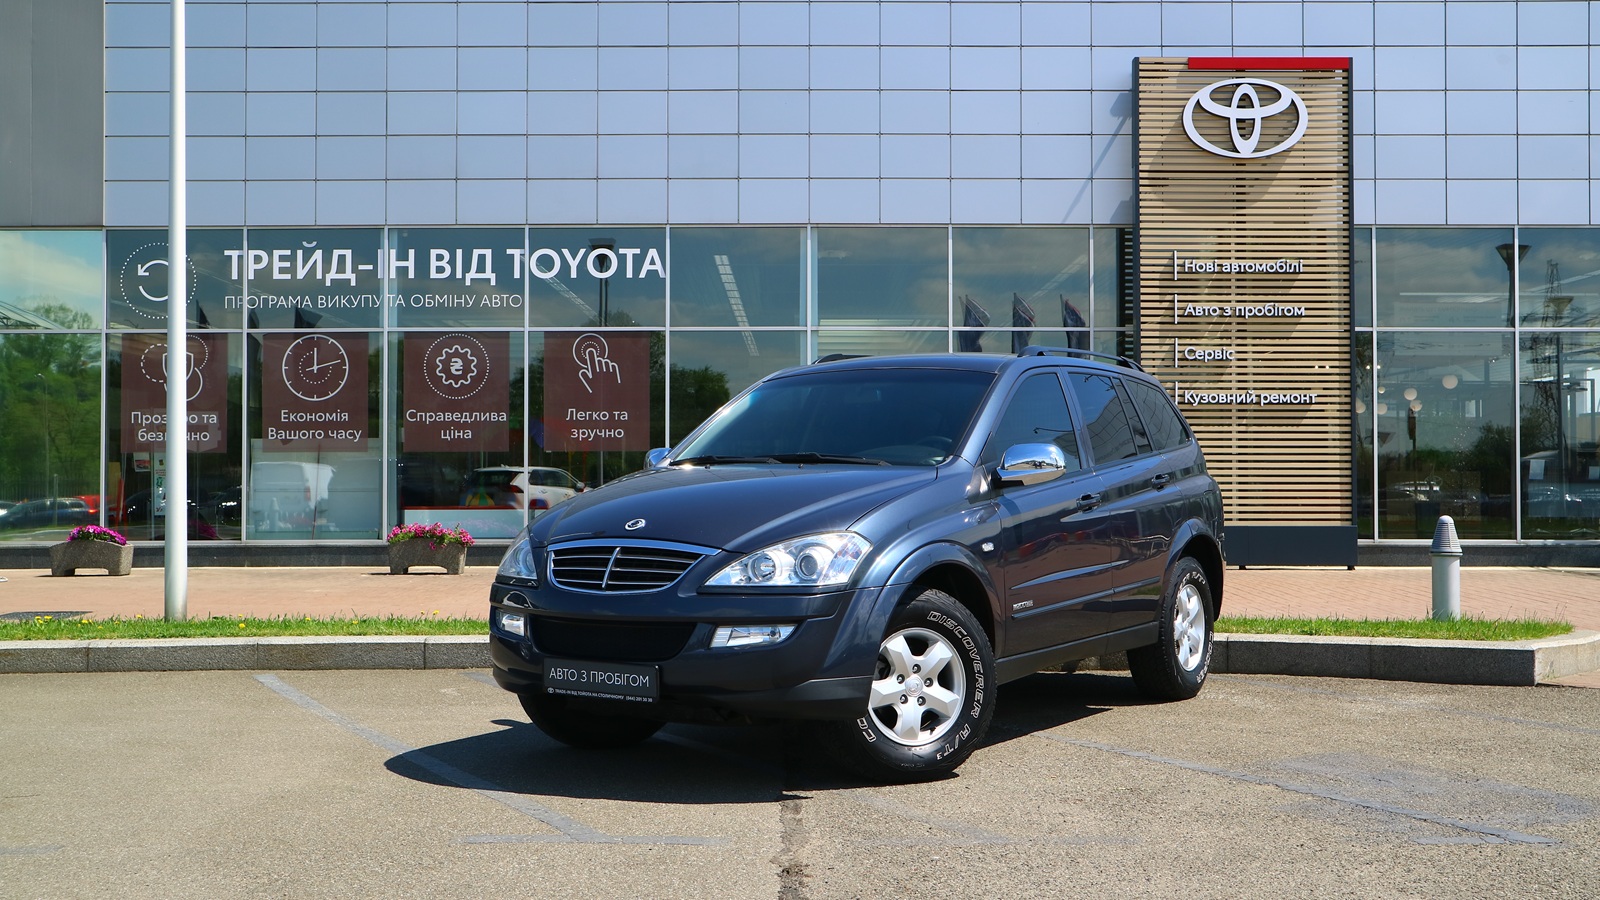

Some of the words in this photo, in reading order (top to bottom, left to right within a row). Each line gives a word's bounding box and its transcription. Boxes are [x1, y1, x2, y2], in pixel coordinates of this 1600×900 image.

[224, 241, 415, 286] ТРЕЙД-ІН
[429, 248, 496, 286] ВІД
[506, 248, 666, 279] TOYOTA
[1184, 259, 1218, 273] Нові
[1222, 259, 1304, 273] автомобілі
[224, 295, 313, 309] ПРОГРАМА
[318, 294, 383, 308] ВИКУПУ
[386, 294, 406, 308] ТА
[410, 294, 476, 308] ОБМІНУ
[480, 294, 522, 308] АВТО
[1184, 303, 1220, 317] Авто
[1223, 305, 1232, 317] з
[1235, 303, 1306, 319] пробігом
[1184, 347, 1235, 363] Сервіс
[1184, 390, 1256, 407] Кузовний
[1260, 392, 1318, 407] ремонт
[131, 411, 198, 426] Прозо
[202, 414, 217, 424] та
[280, 409, 349, 422] Економія
[406, 409, 507, 425] Справедлива
[565, 408, 609, 421] Легко
[612, 411, 628, 421] та
[268, 428, 325, 440] Вашого
[329, 429, 362, 442] часу
[440, 426, 472, 440] ціна
[570, 428, 624, 441] зручно
[927, 611, 984, 719] DISCOVERER
[549, 667, 578, 681] АВТО
[590, 671, 650, 688] ПРОБІГОМ
